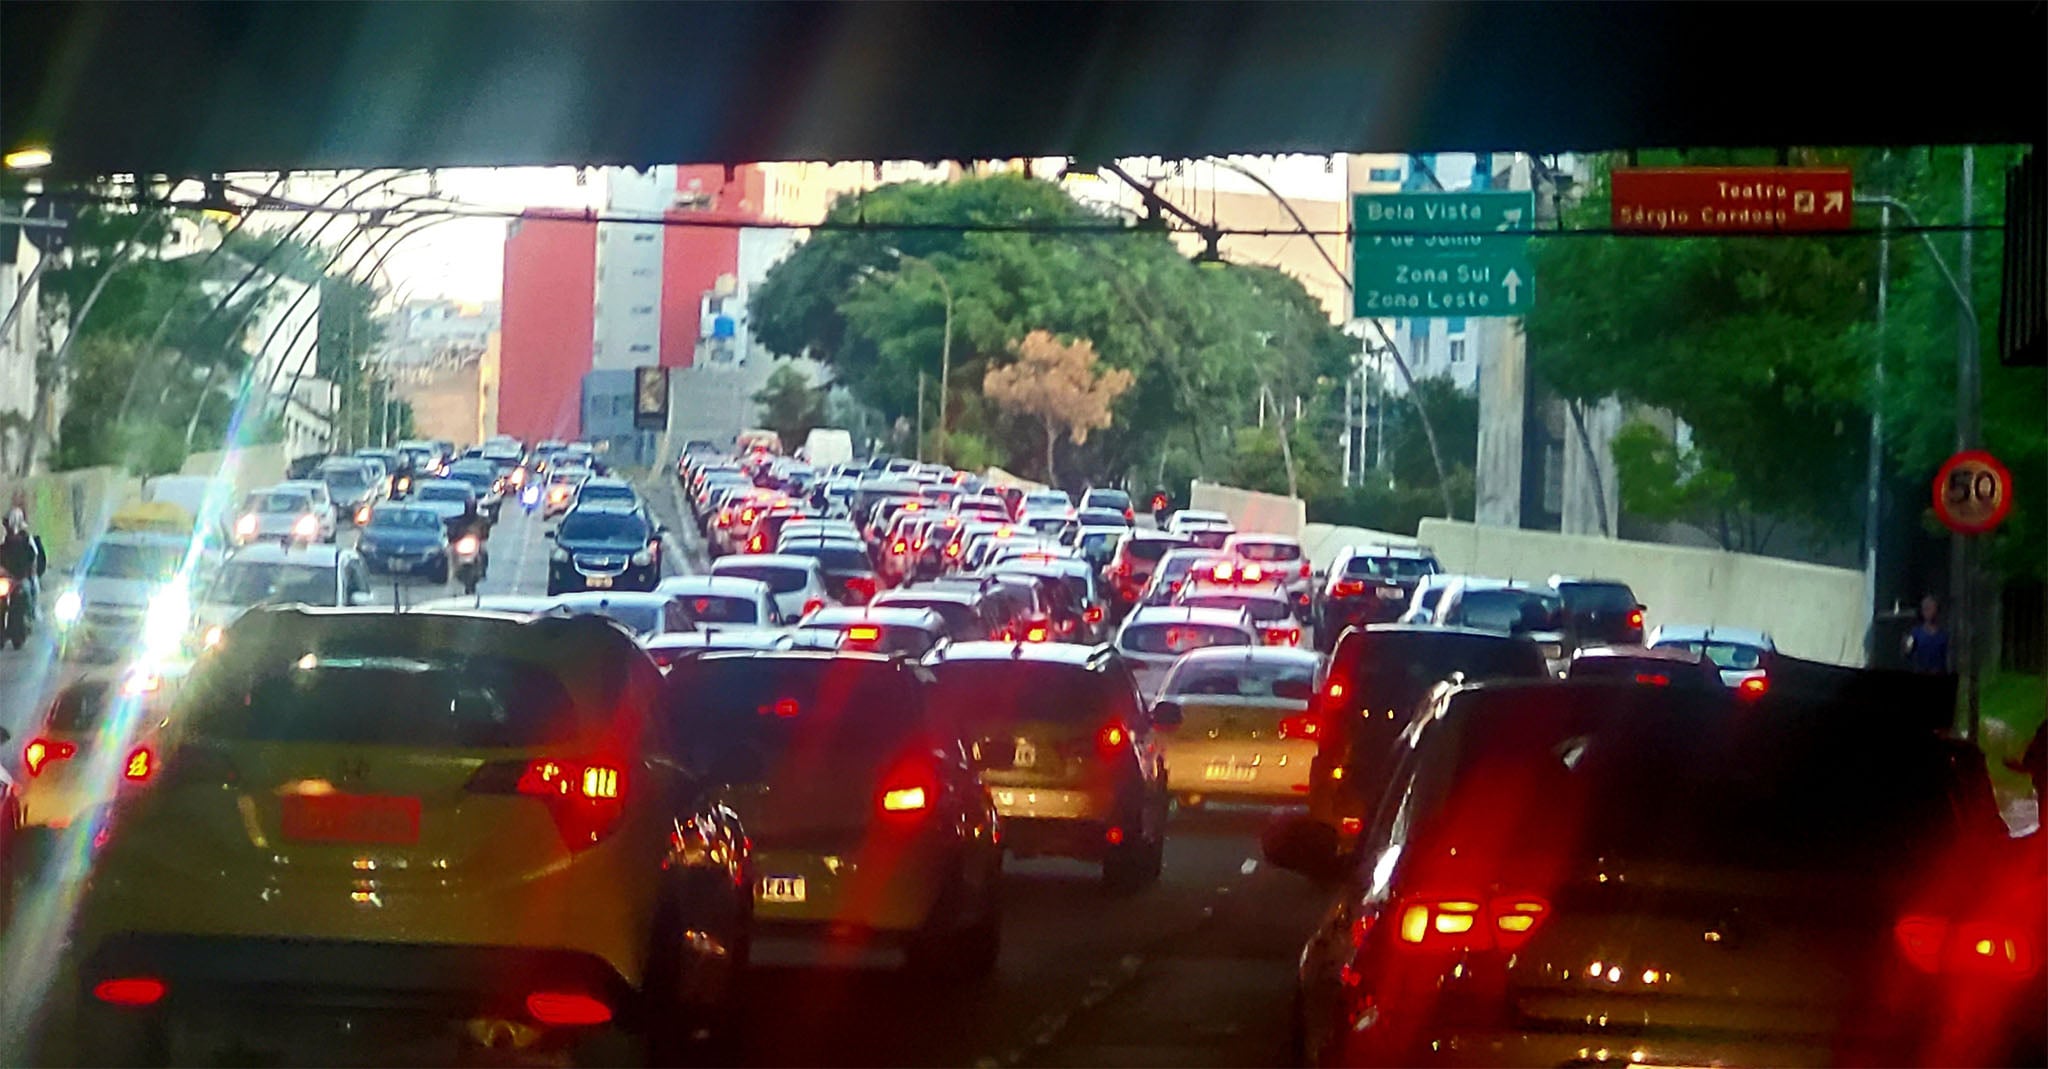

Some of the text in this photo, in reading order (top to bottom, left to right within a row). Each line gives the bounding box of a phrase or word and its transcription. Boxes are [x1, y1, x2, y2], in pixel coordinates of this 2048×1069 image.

[1718, 181, 1787, 199] Teatro
[1368, 201, 1481, 220] Bela Vista
[1620, 205, 1787, 229] Sérgio Cardoso
[1396, 264, 1489, 284] Zona Sul
[1367, 290, 1489, 308] Zona Leste
[1948, 469, 1996, 503] 50
